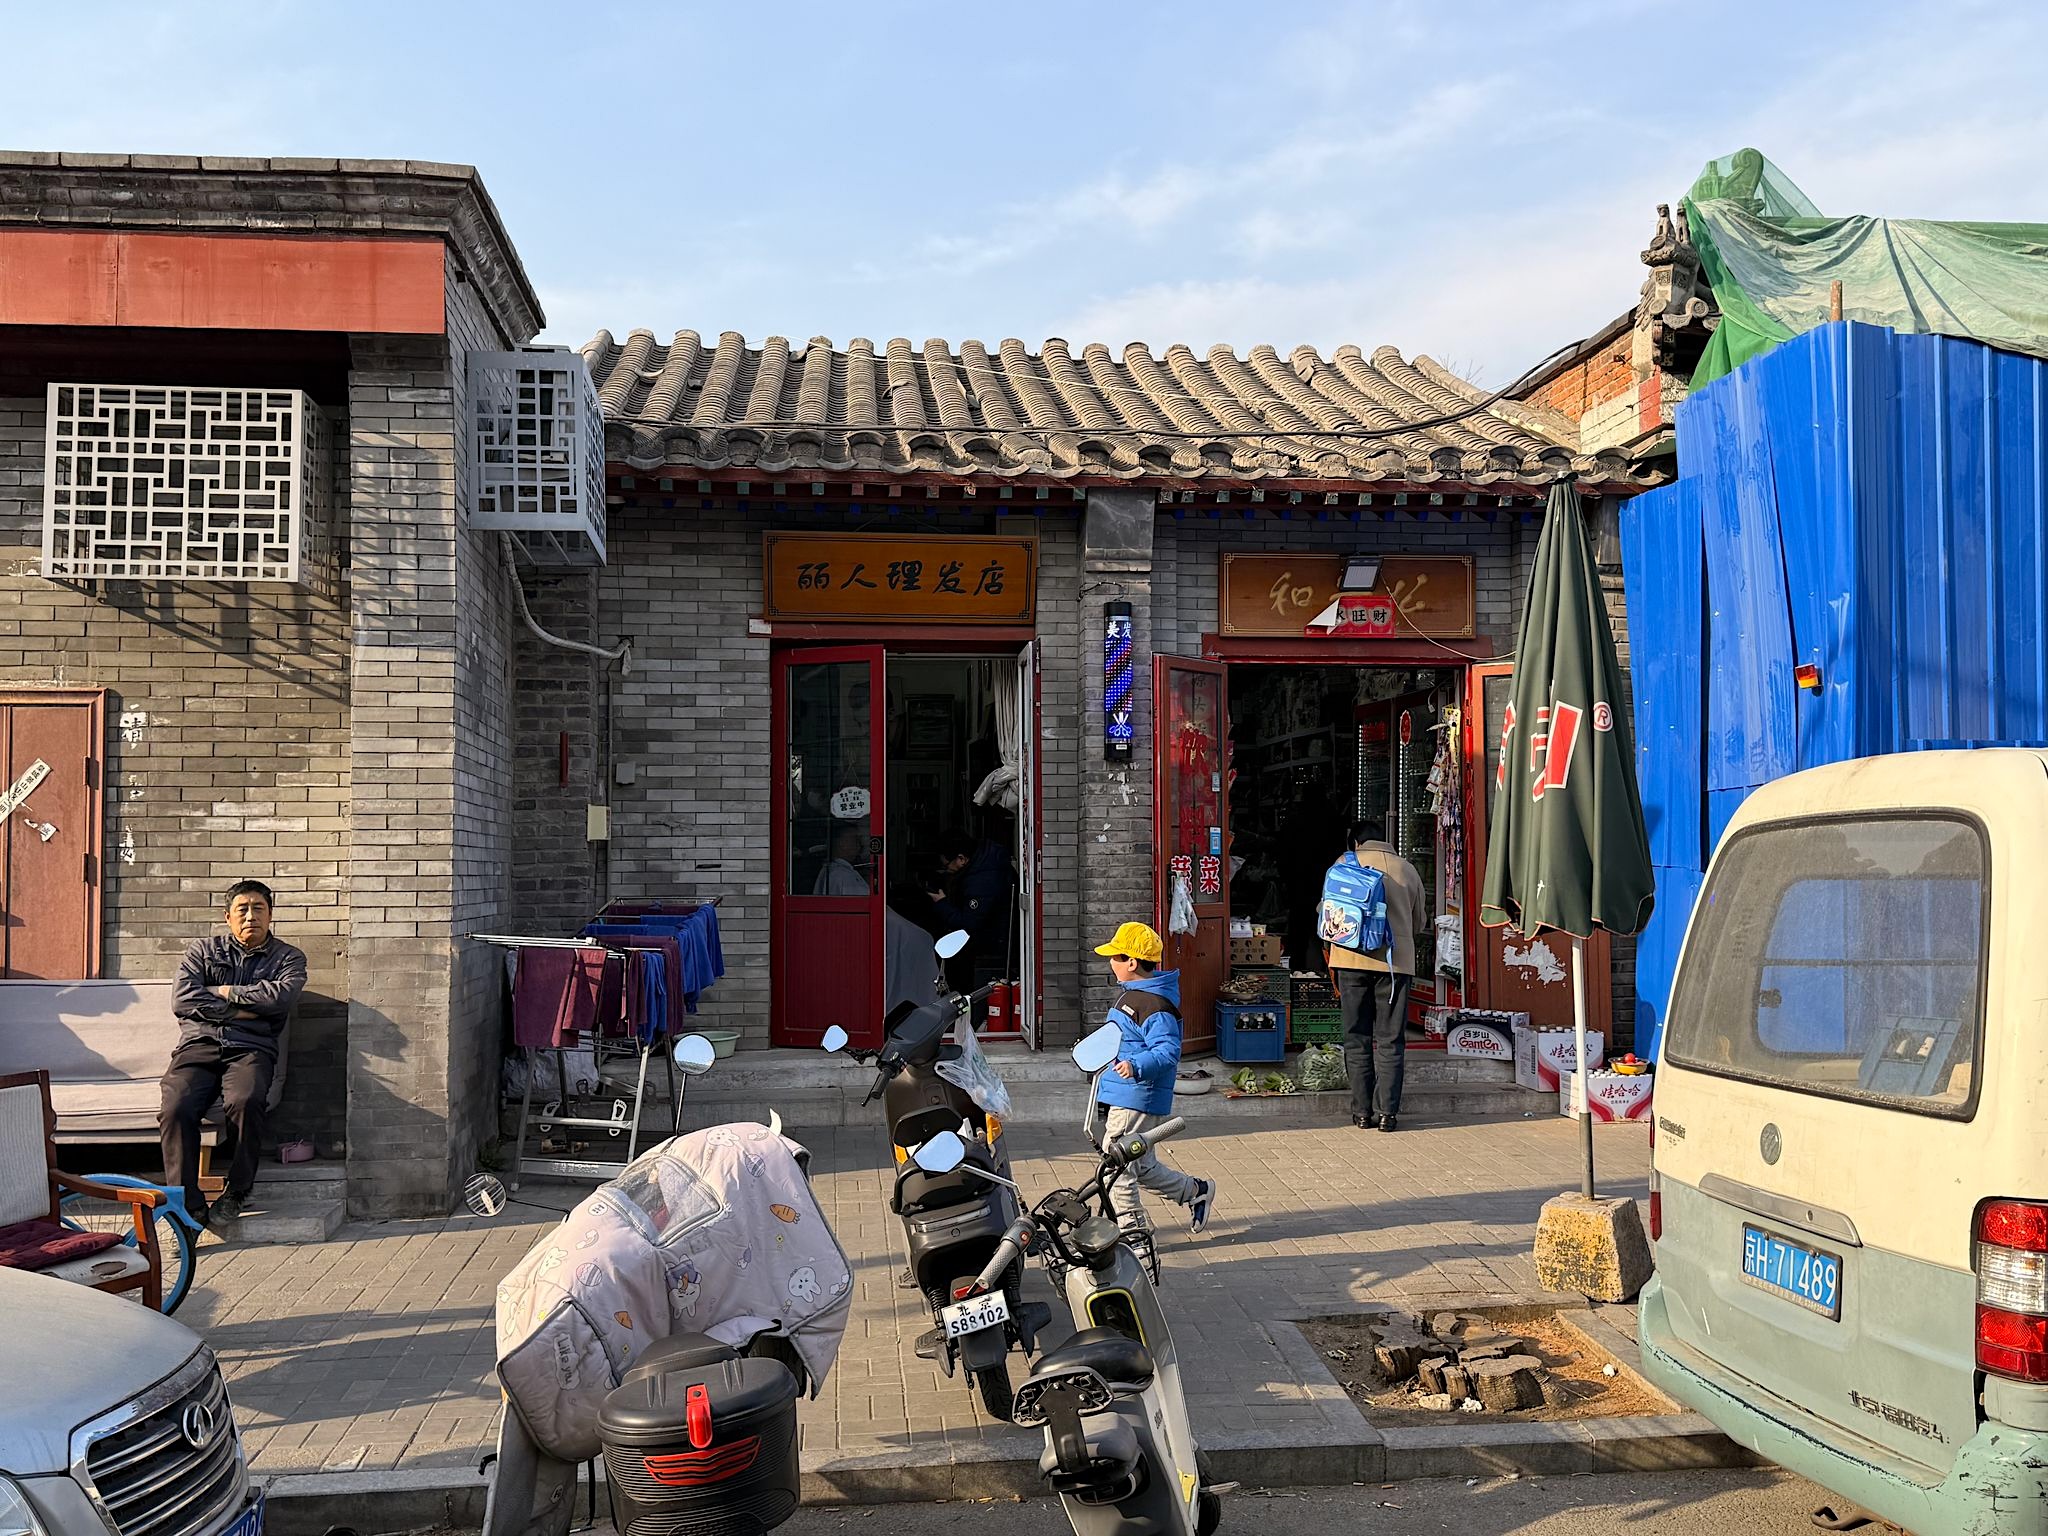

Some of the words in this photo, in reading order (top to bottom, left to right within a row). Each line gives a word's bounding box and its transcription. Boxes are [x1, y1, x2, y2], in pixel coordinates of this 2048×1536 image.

[797, 560, 1004, 596] 丽人理发店
[1107, 621, 1131, 638] 美发
[1600, 1083, 1640, 1099] 娃哈哈
[951, 1306, 1005, 1334] S88102
